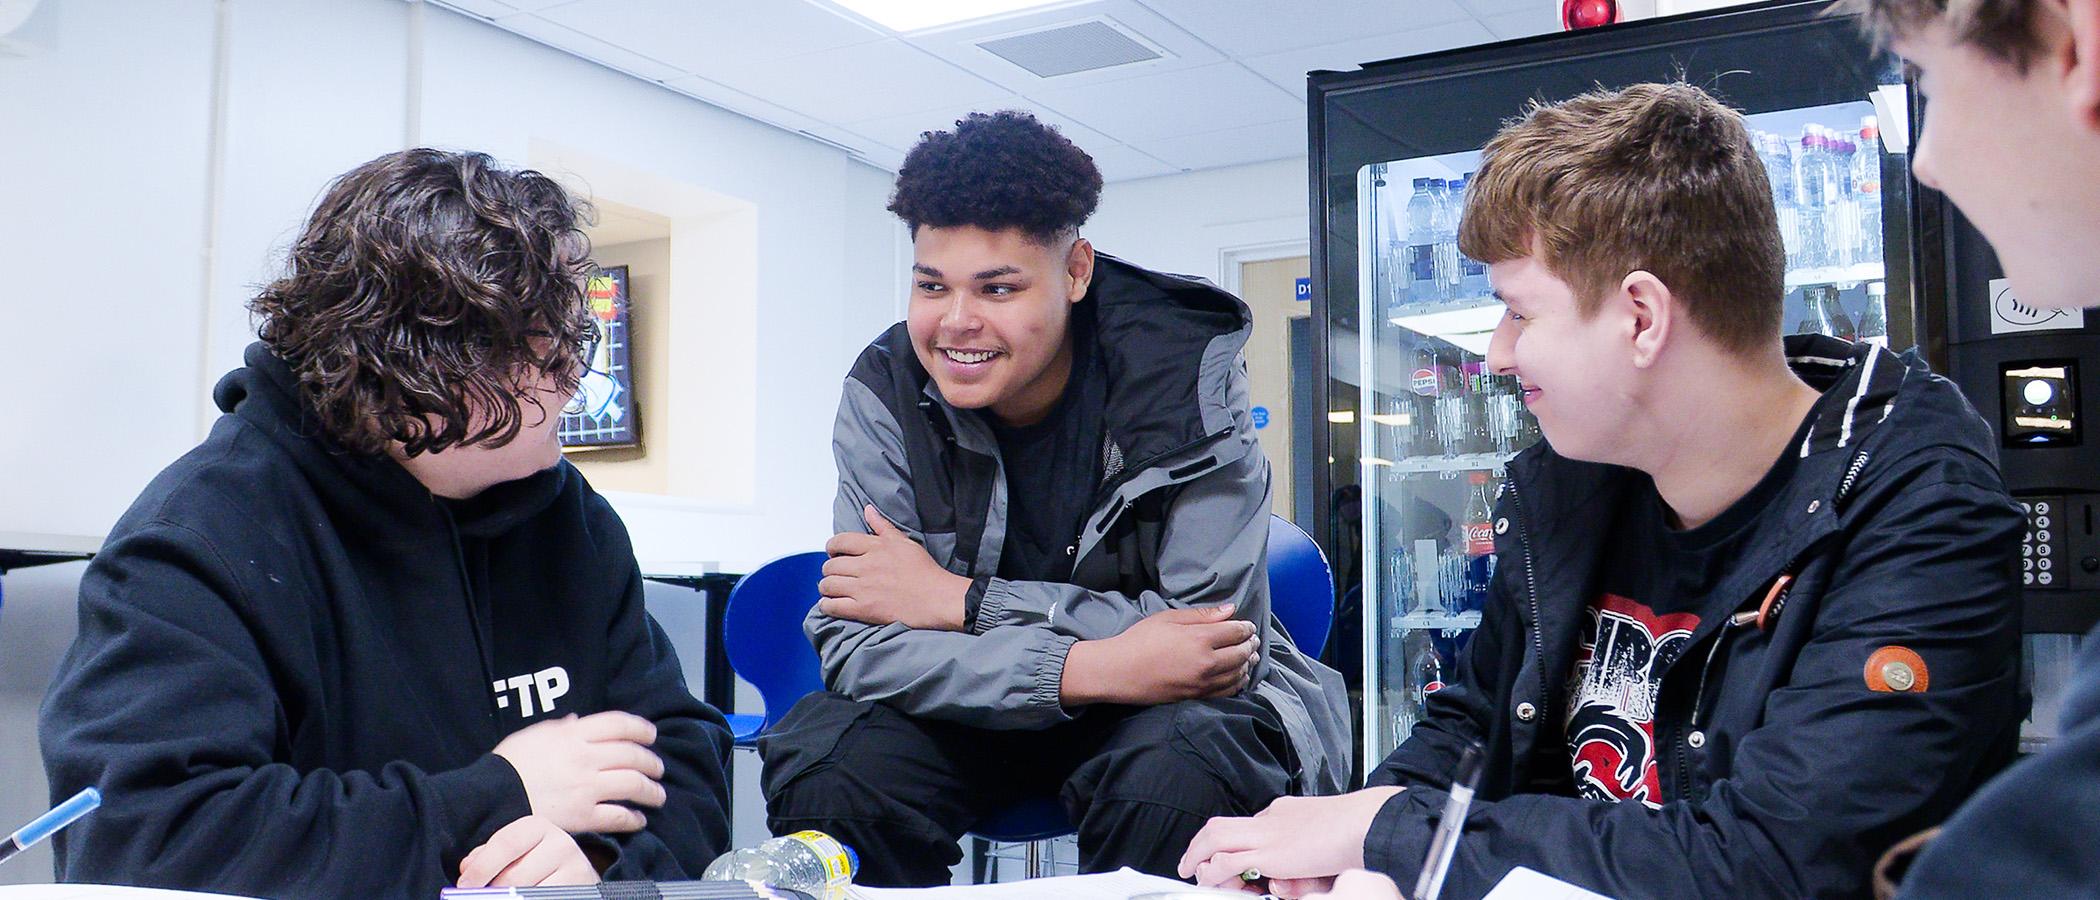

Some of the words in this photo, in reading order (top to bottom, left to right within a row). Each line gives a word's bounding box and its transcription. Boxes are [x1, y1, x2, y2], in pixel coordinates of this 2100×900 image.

[2038, 504, 2044, 512] 2
[2038, 518, 2045, 526] 4
[2039, 532, 2045, 540] 6
[2040, 546, 2046, 554] 8
[2040, 559, 2047, 568] 0
